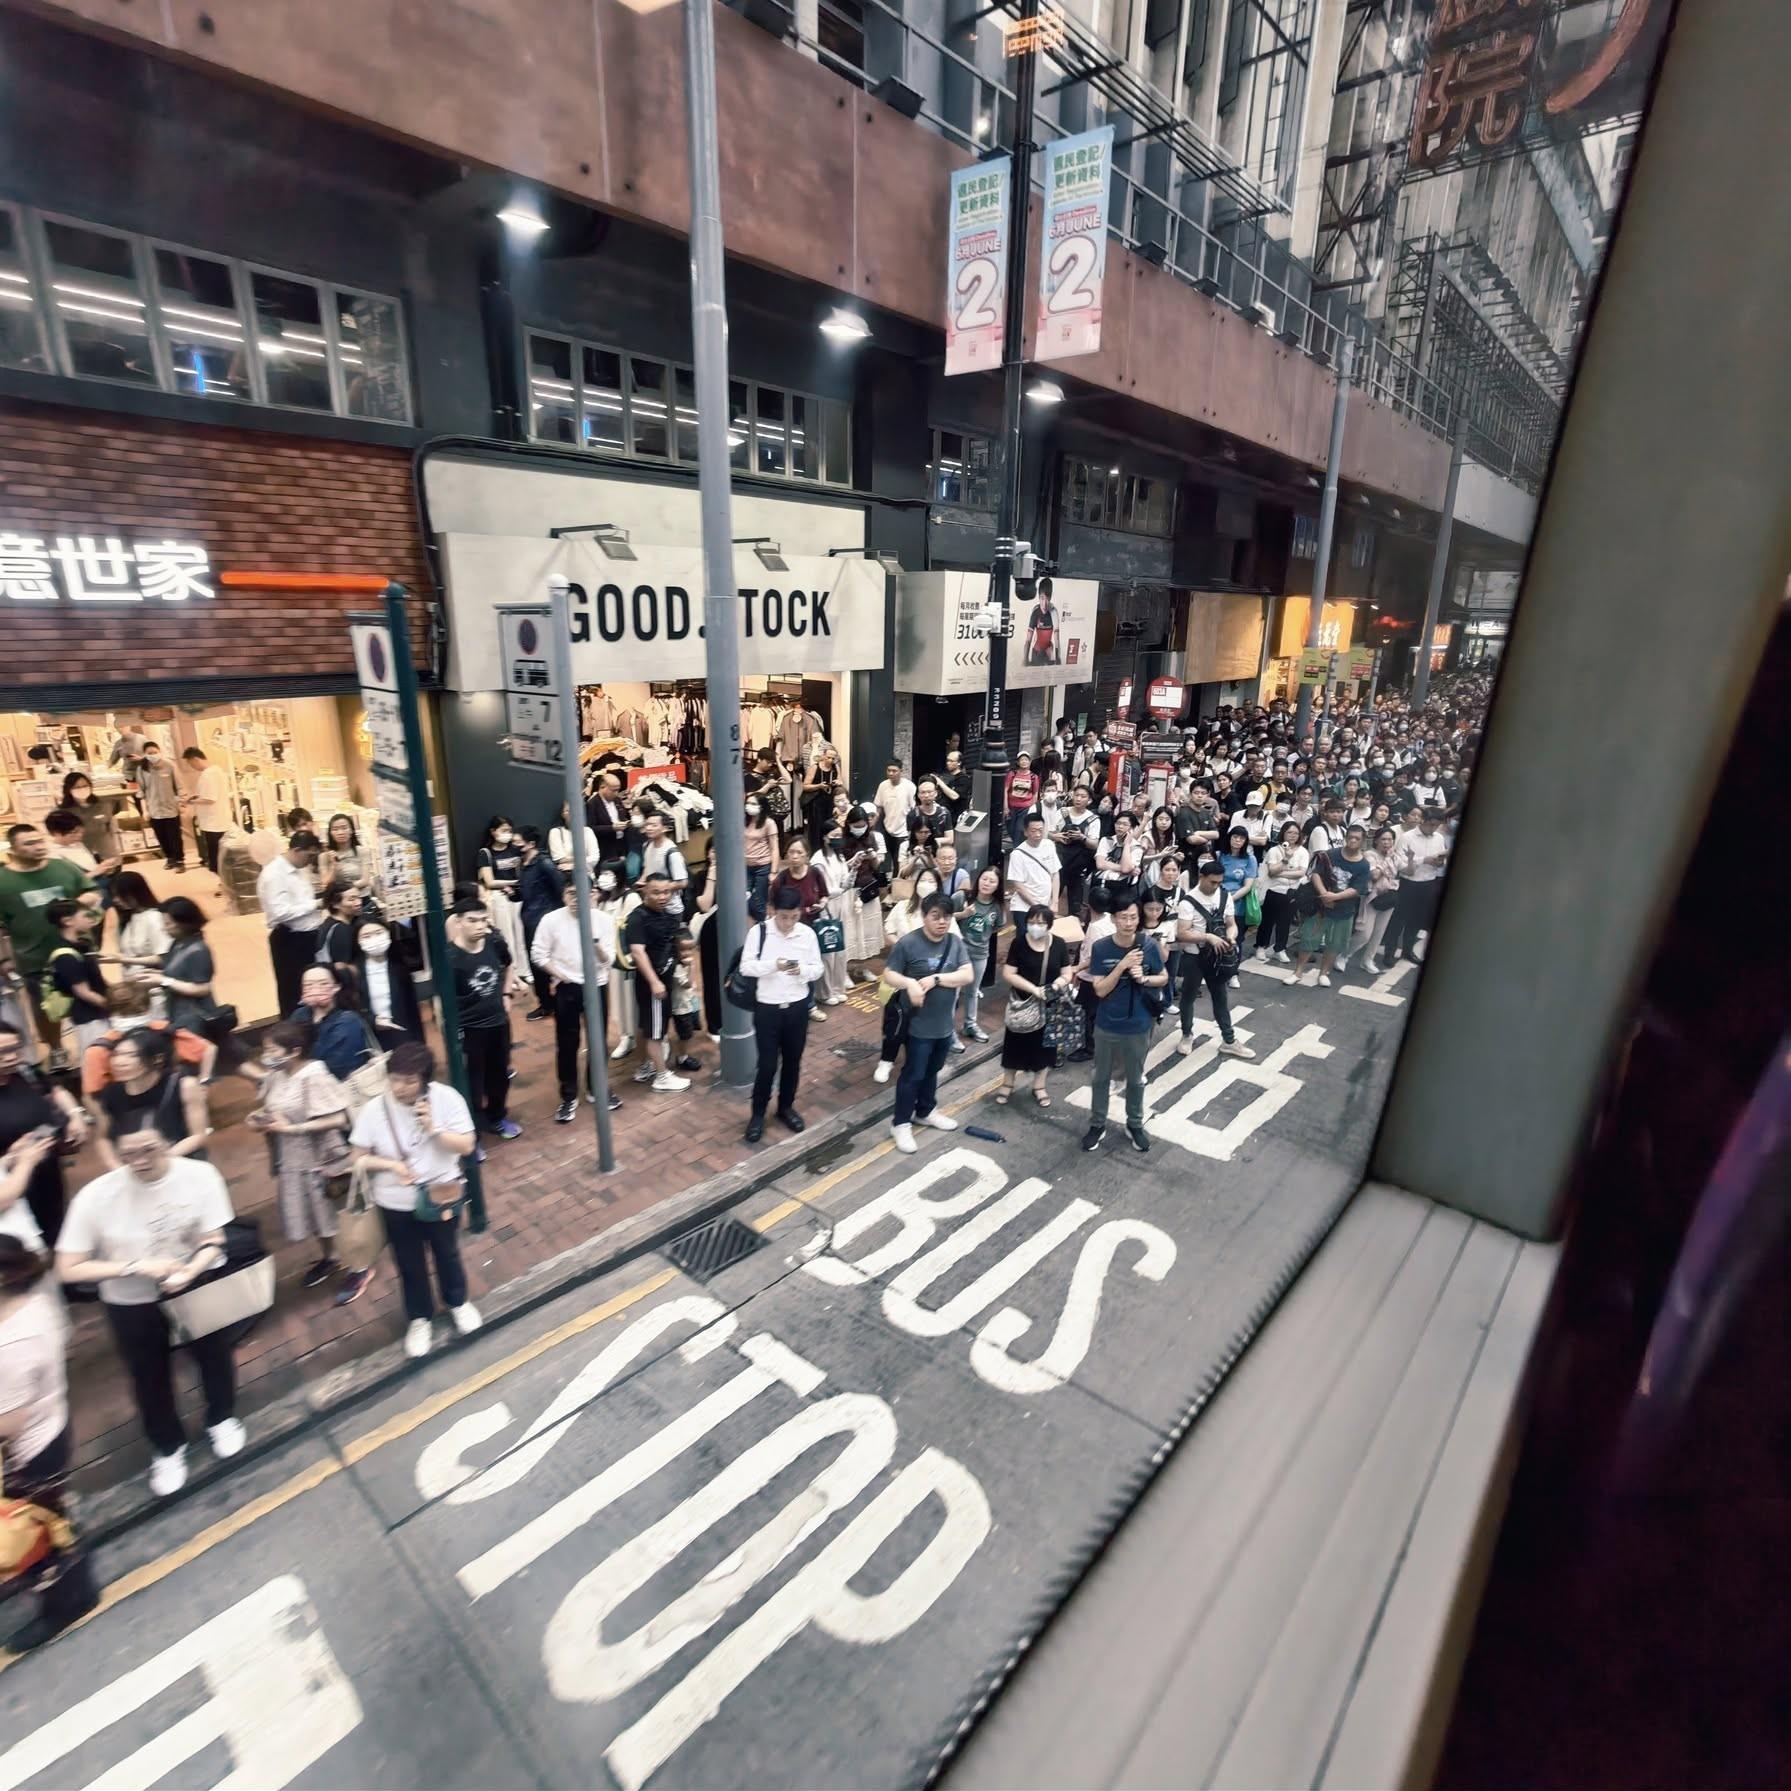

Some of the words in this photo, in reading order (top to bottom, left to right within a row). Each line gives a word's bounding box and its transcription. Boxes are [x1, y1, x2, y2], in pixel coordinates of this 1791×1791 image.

[955, 257, 998, 331] 2
[1049, 234, 1098, 314] 2
[566, 583, 831, 643] GOOD.TOCK
[795, 1148, 1177, 1394] BUS
[415, 1295, 992, 1791] STOP
